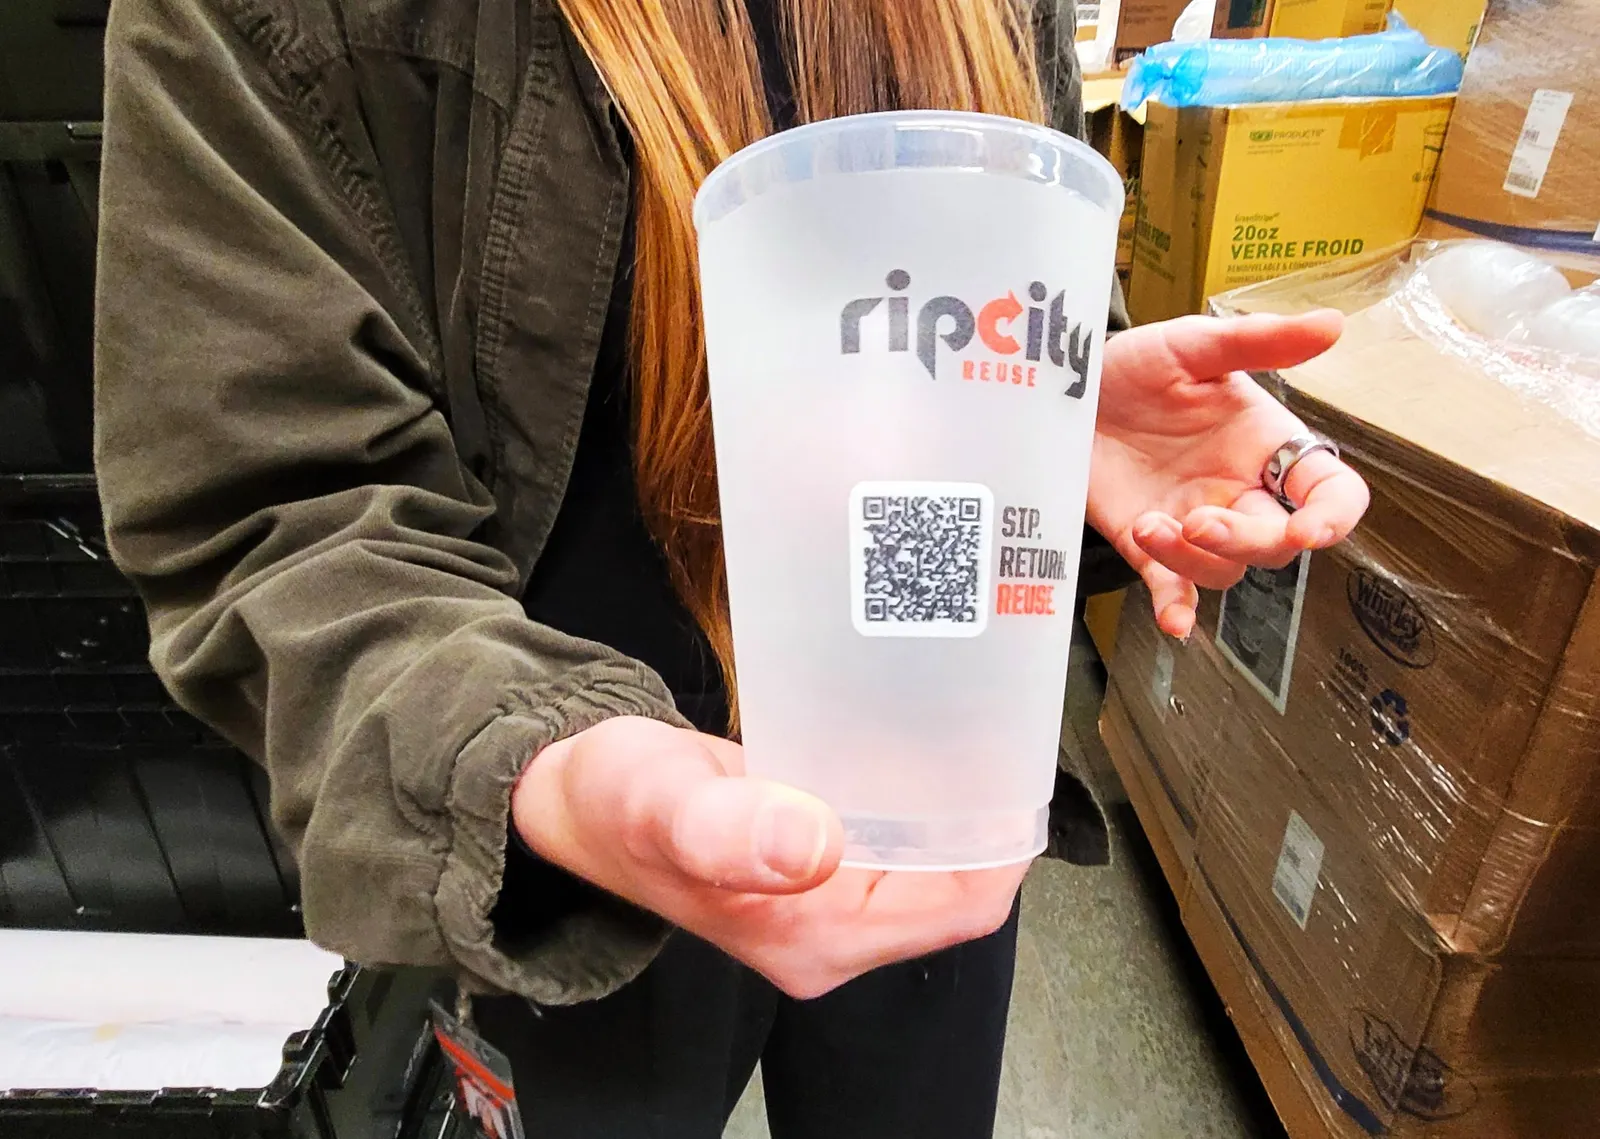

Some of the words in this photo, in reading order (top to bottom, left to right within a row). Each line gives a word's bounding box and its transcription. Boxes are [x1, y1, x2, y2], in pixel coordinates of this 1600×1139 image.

[1232, 225, 1280, 241] 20oz
[1231, 242, 1298, 260] VERRE
[1302, 238, 1364, 257] FROID
[962, 360, 1037, 387] REUSE
[1002, 505, 1042, 539] SIP.
[1000, 545, 1067, 580] RETURN.
[996, 583, 1056, 615] REUSE.
